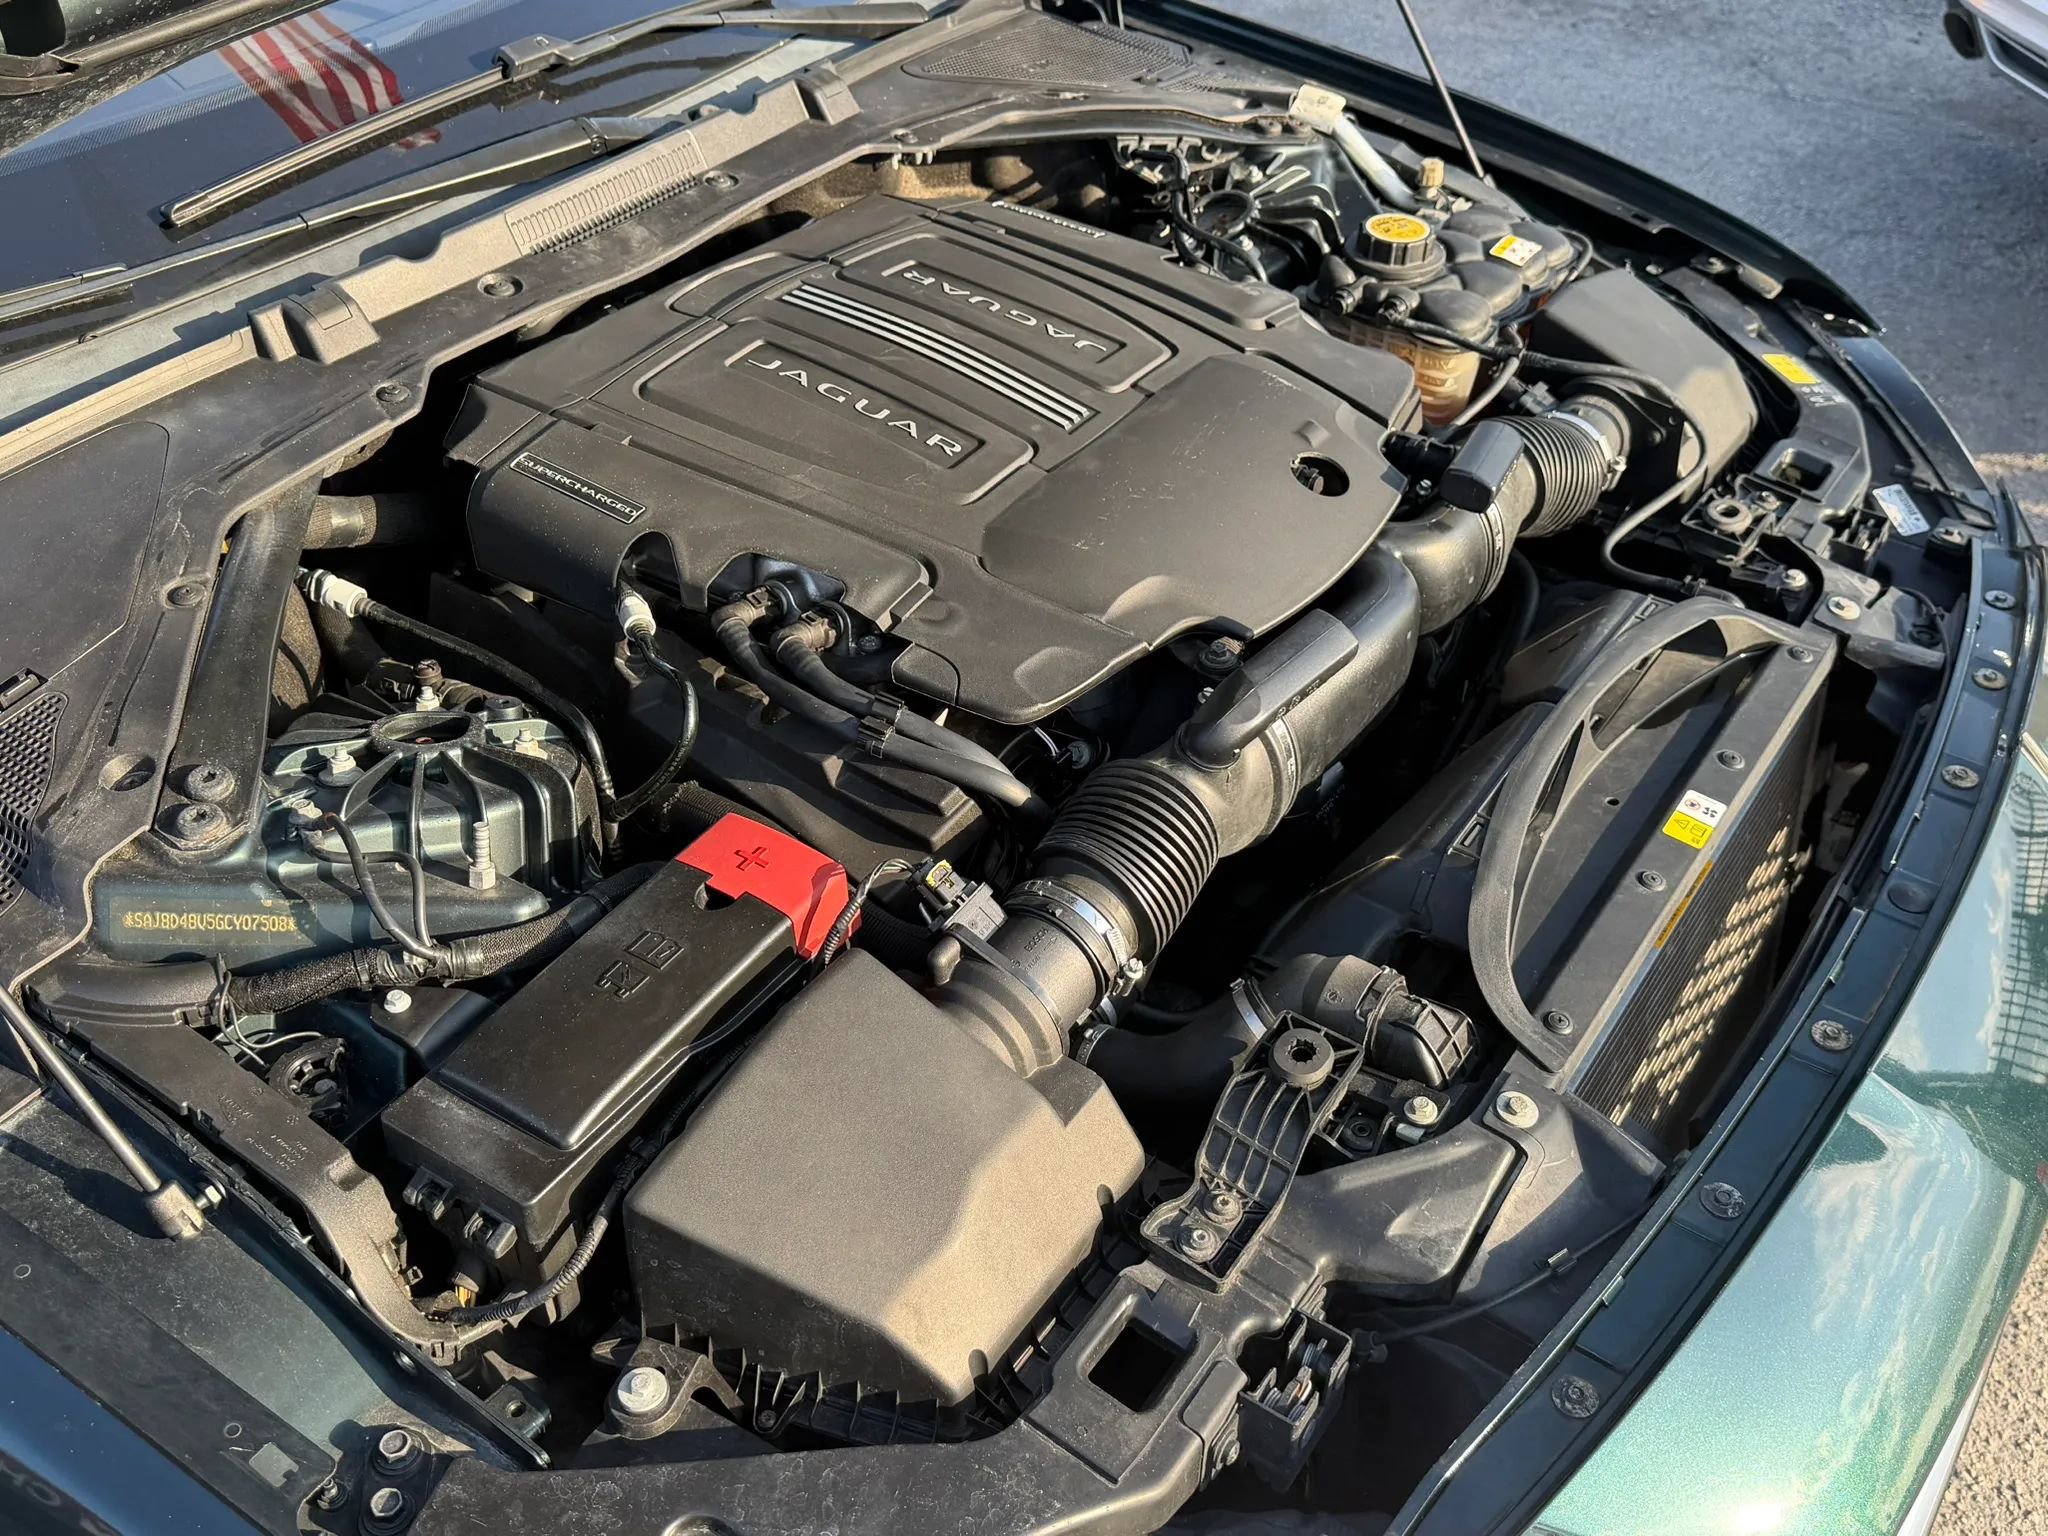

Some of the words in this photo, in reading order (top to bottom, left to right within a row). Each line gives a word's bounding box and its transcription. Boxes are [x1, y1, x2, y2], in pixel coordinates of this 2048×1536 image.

[903, 270, 1107, 351] JAGUAR
[746, 358, 962, 457] JAGUAR
[518, 457, 637, 516] SUPERCHARGED
